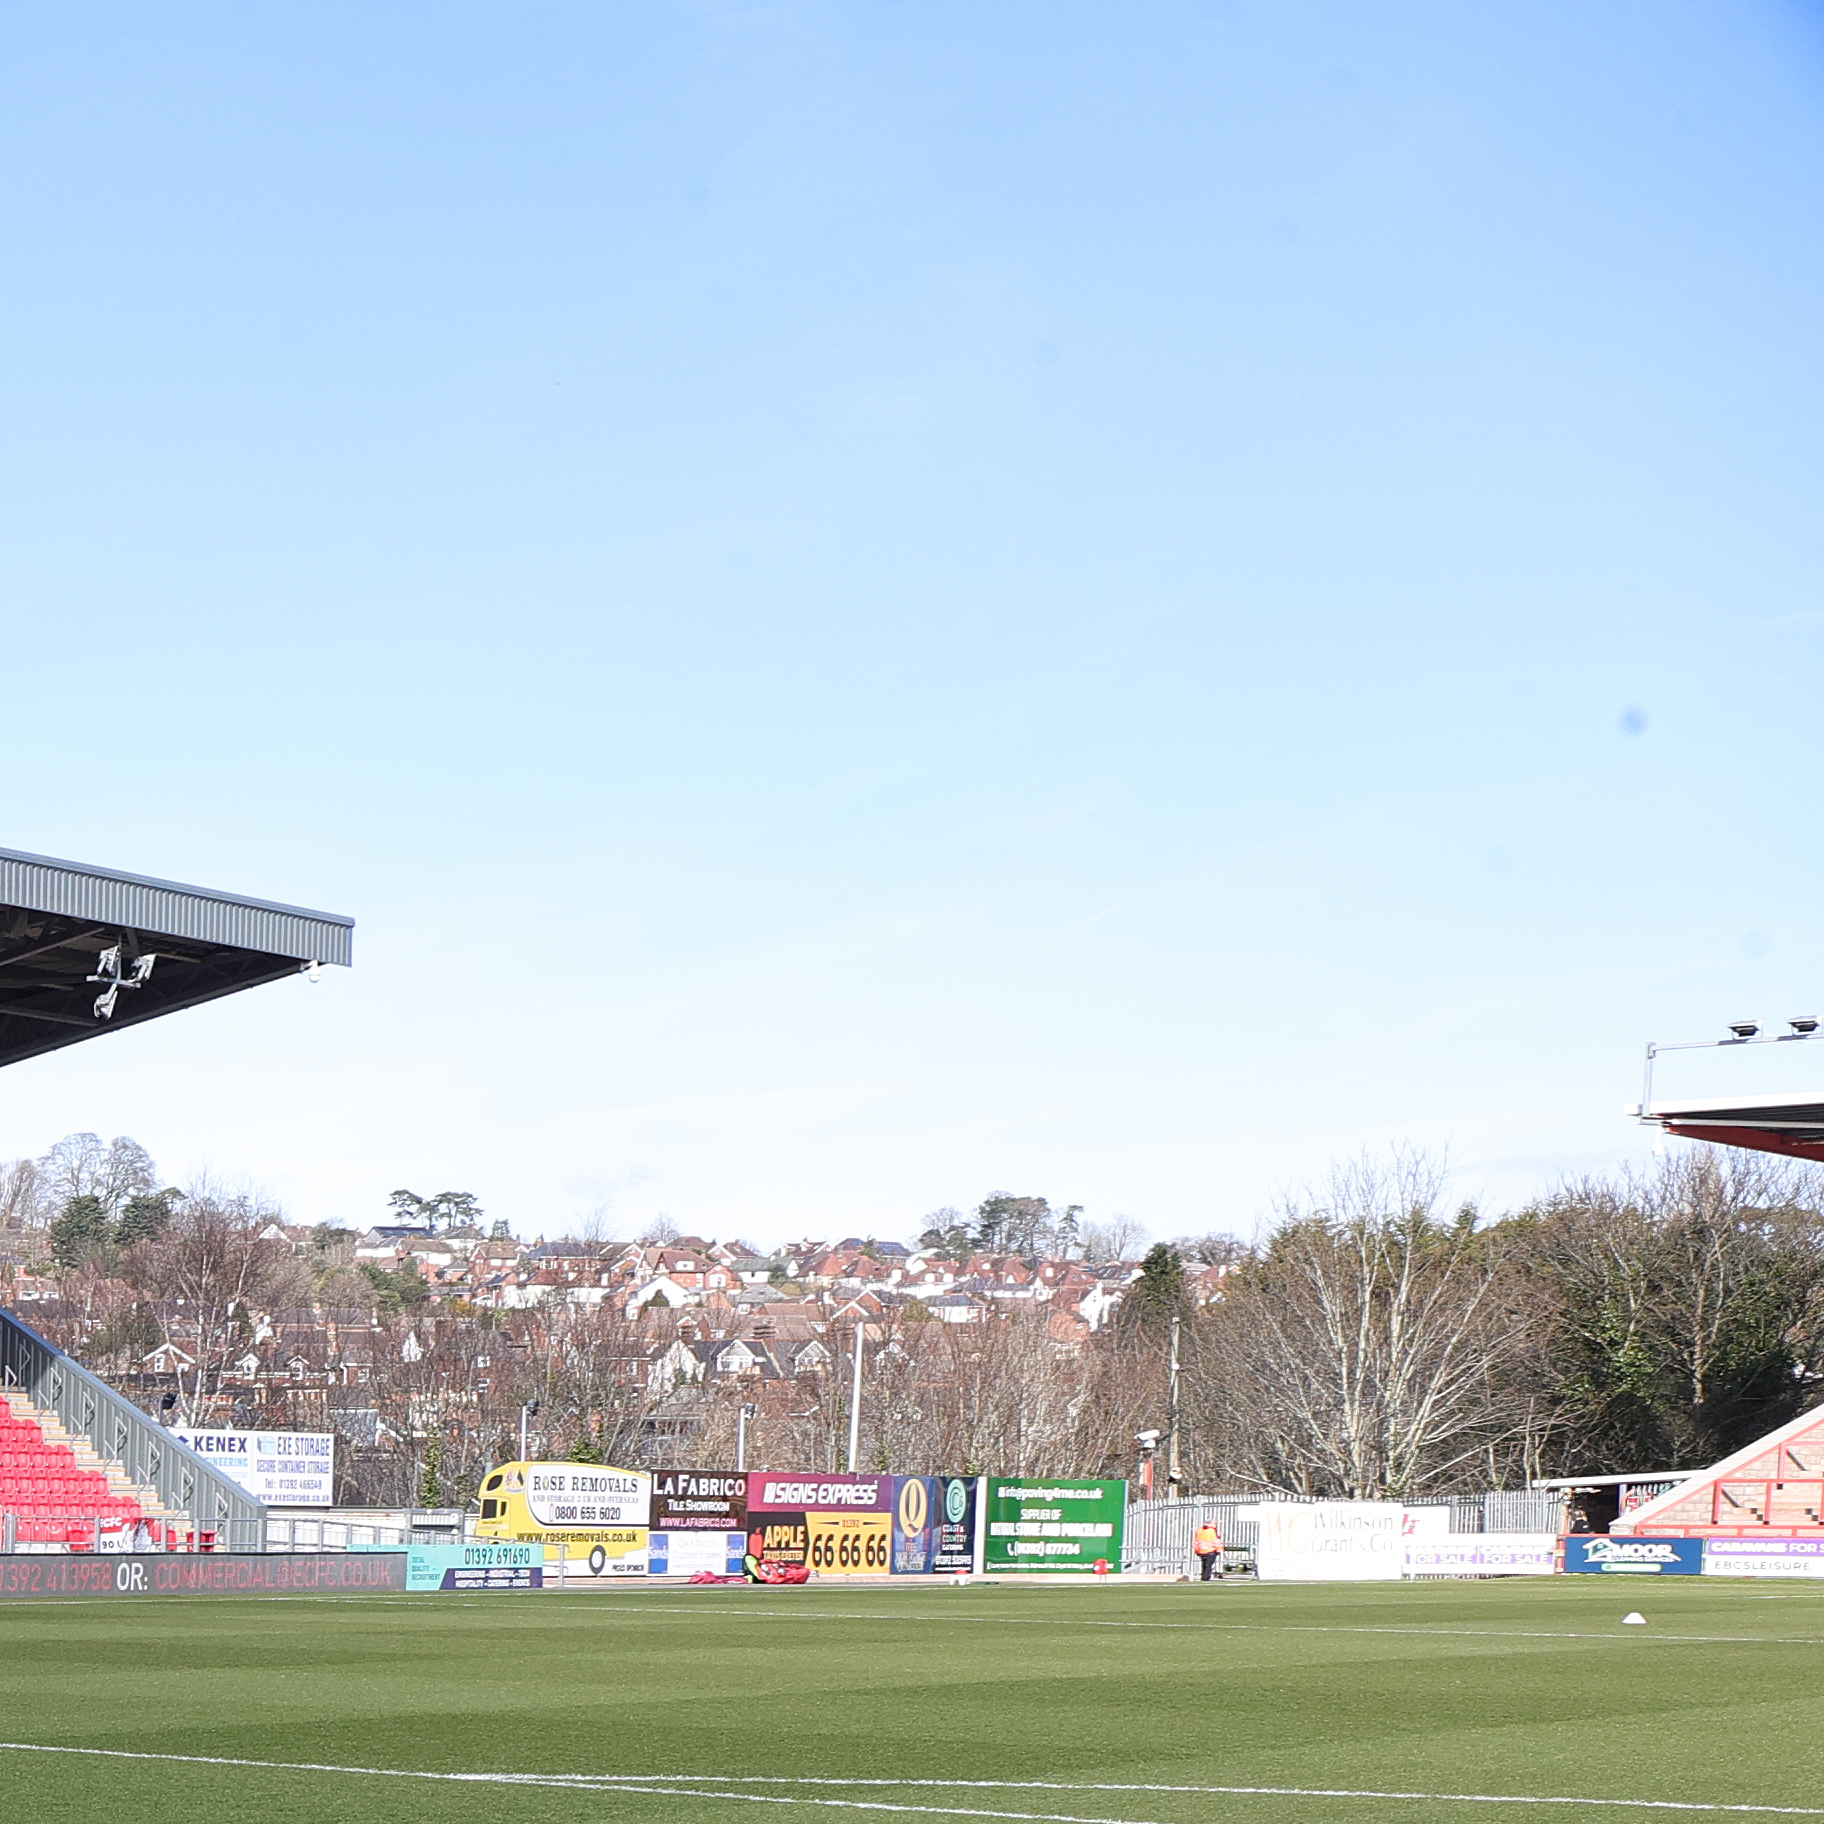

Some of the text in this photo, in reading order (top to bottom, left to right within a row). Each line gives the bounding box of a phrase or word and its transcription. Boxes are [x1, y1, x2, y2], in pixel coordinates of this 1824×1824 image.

[194, 1436, 248, 1453] KENEX
[277, 1437, 330, 1456] EXE STORAGE
[256, 1460, 330, 1474] SECURE CONTAINER STORAGE
[265, 1478, 276, 1489] Tel:
[533, 1476, 638, 1493] ROSE REMOVALS
[653, 1473, 746, 1496] LA FABRICO
[532, 1495, 546, 1503] AND
[547, 1495, 575, 1503] STORAGE
[593, 1495, 606, 1503] AND
[607, 1496, 639, 1504] OVERSEAS
[775, 1483, 878, 1505] SIGNS EXPRESS
[667, 1499, 730, 1511] TILE SHOWROOM
[555, 1506, 576, 1520] 0800
[600, 1506, 621, 1520] 6020
[1052, 1509, 1062, 1520] OF
[1313, 1510, 1393, 1530] Wilkinson
[517, 1529, 638, 1544] www.roseremovals.co.uk
[763, 1525, 805, 1548] APPLE
[1312, 1533, 1353, 1553] Grant
[1370, 1533, 1393, 1552] Co
[1613, 1543, 1673, 1557] MOOR
[1710, 1542, 1787, 1553] CARAVANS
[1789, 1543, 1818, 1553] FOR
[464, 1548, 530, 1565] 01392 691690
[1410, 1554, 1472, 1563] OR SALE
[1483, 1554, 1549, 1563] FOR SALE
[1714, 1561, 1810, 1570] EBCSLEISURE
[46, 1561, 113, 1593] 413958
[116, 1561, 149, 1592] OR:
[155, 1560, 393, 1591] COMMERCIAL@ECFC.CO.UK
